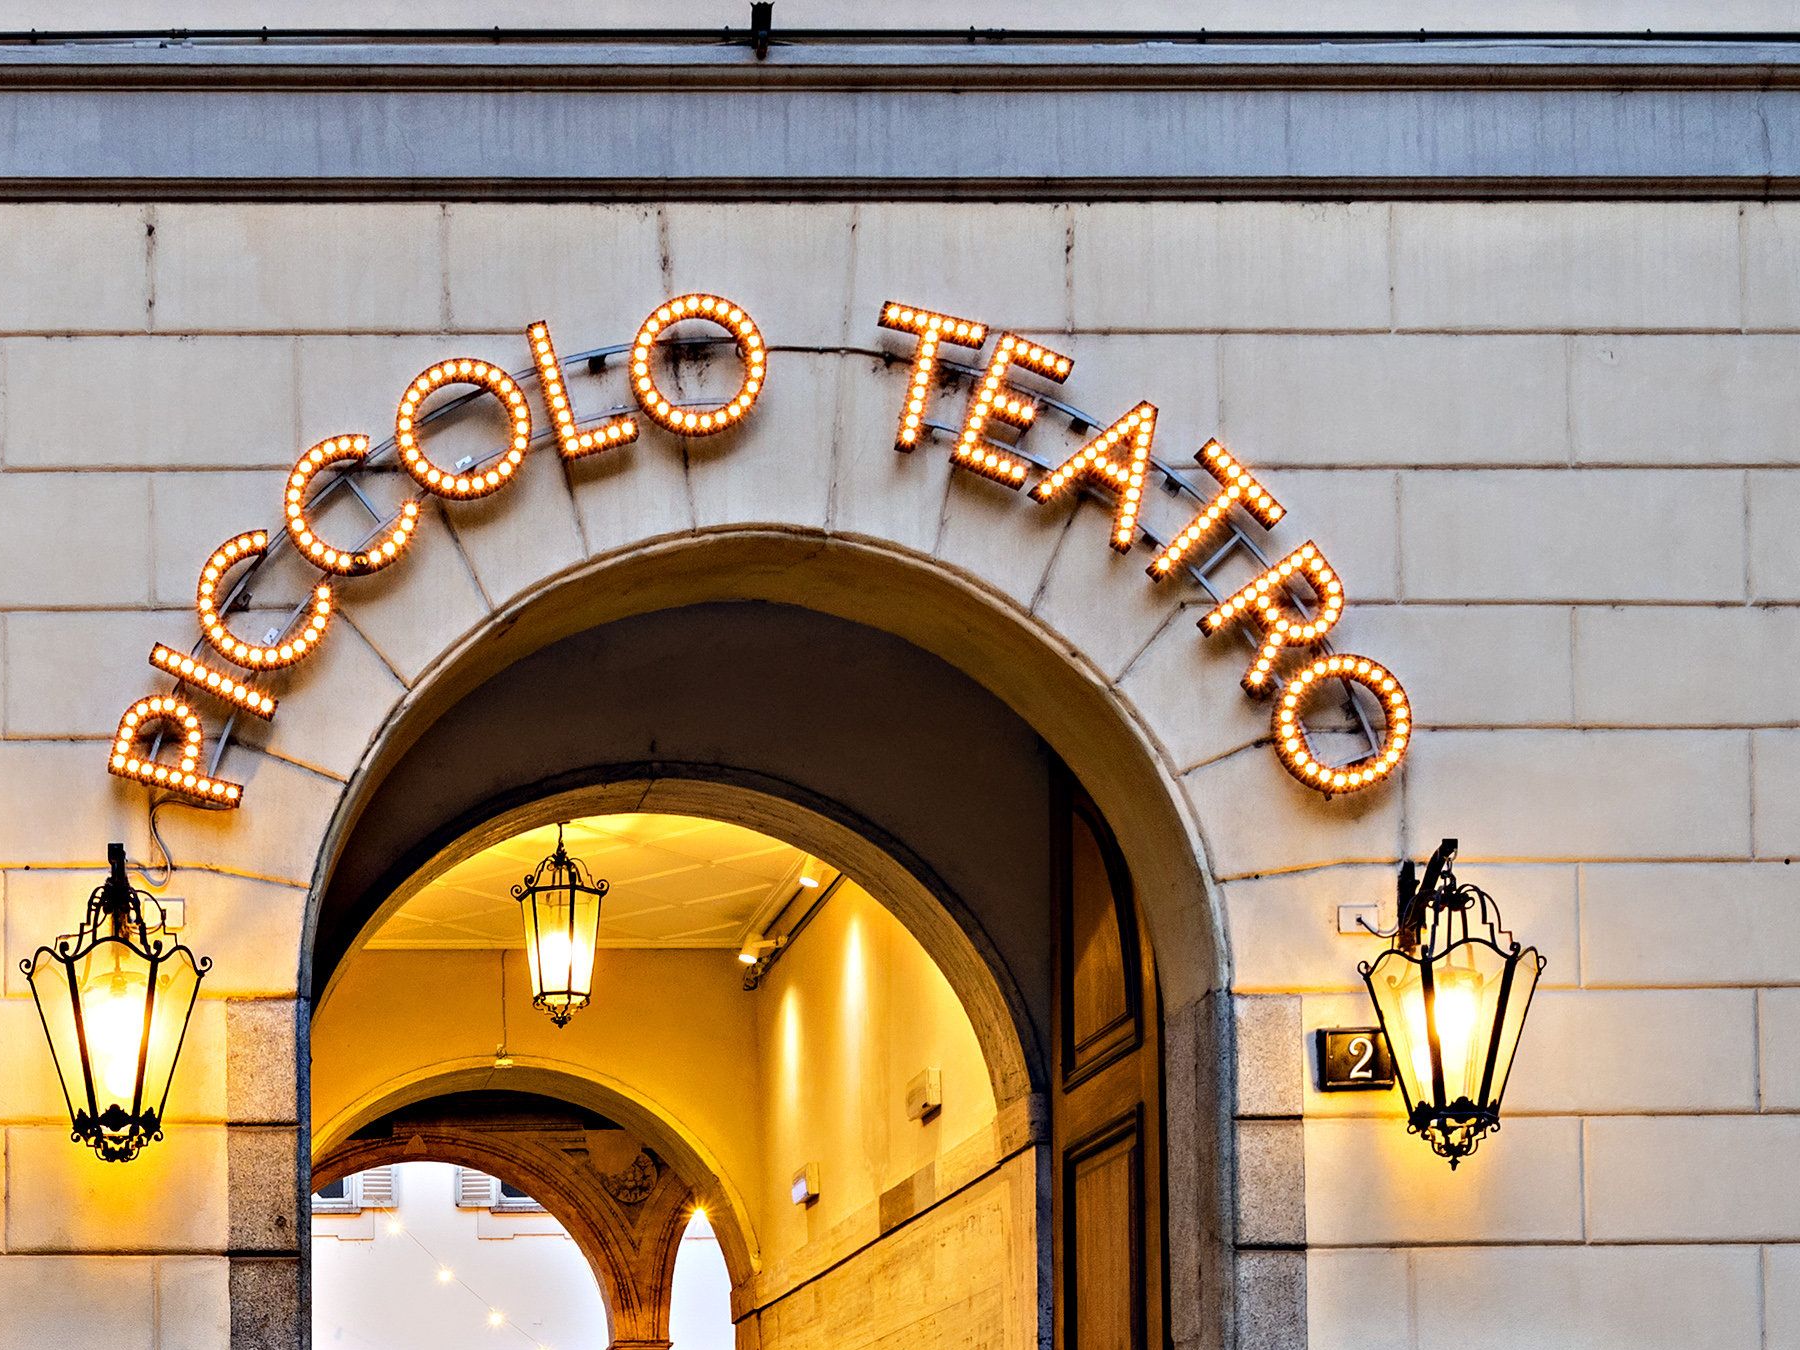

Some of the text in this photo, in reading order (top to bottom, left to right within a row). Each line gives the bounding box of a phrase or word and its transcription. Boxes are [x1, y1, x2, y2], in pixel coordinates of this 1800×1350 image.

[108, 294, 1411, 807] PICCOLO TEATRO
[1349, 1037, 1374, 1079] 2
